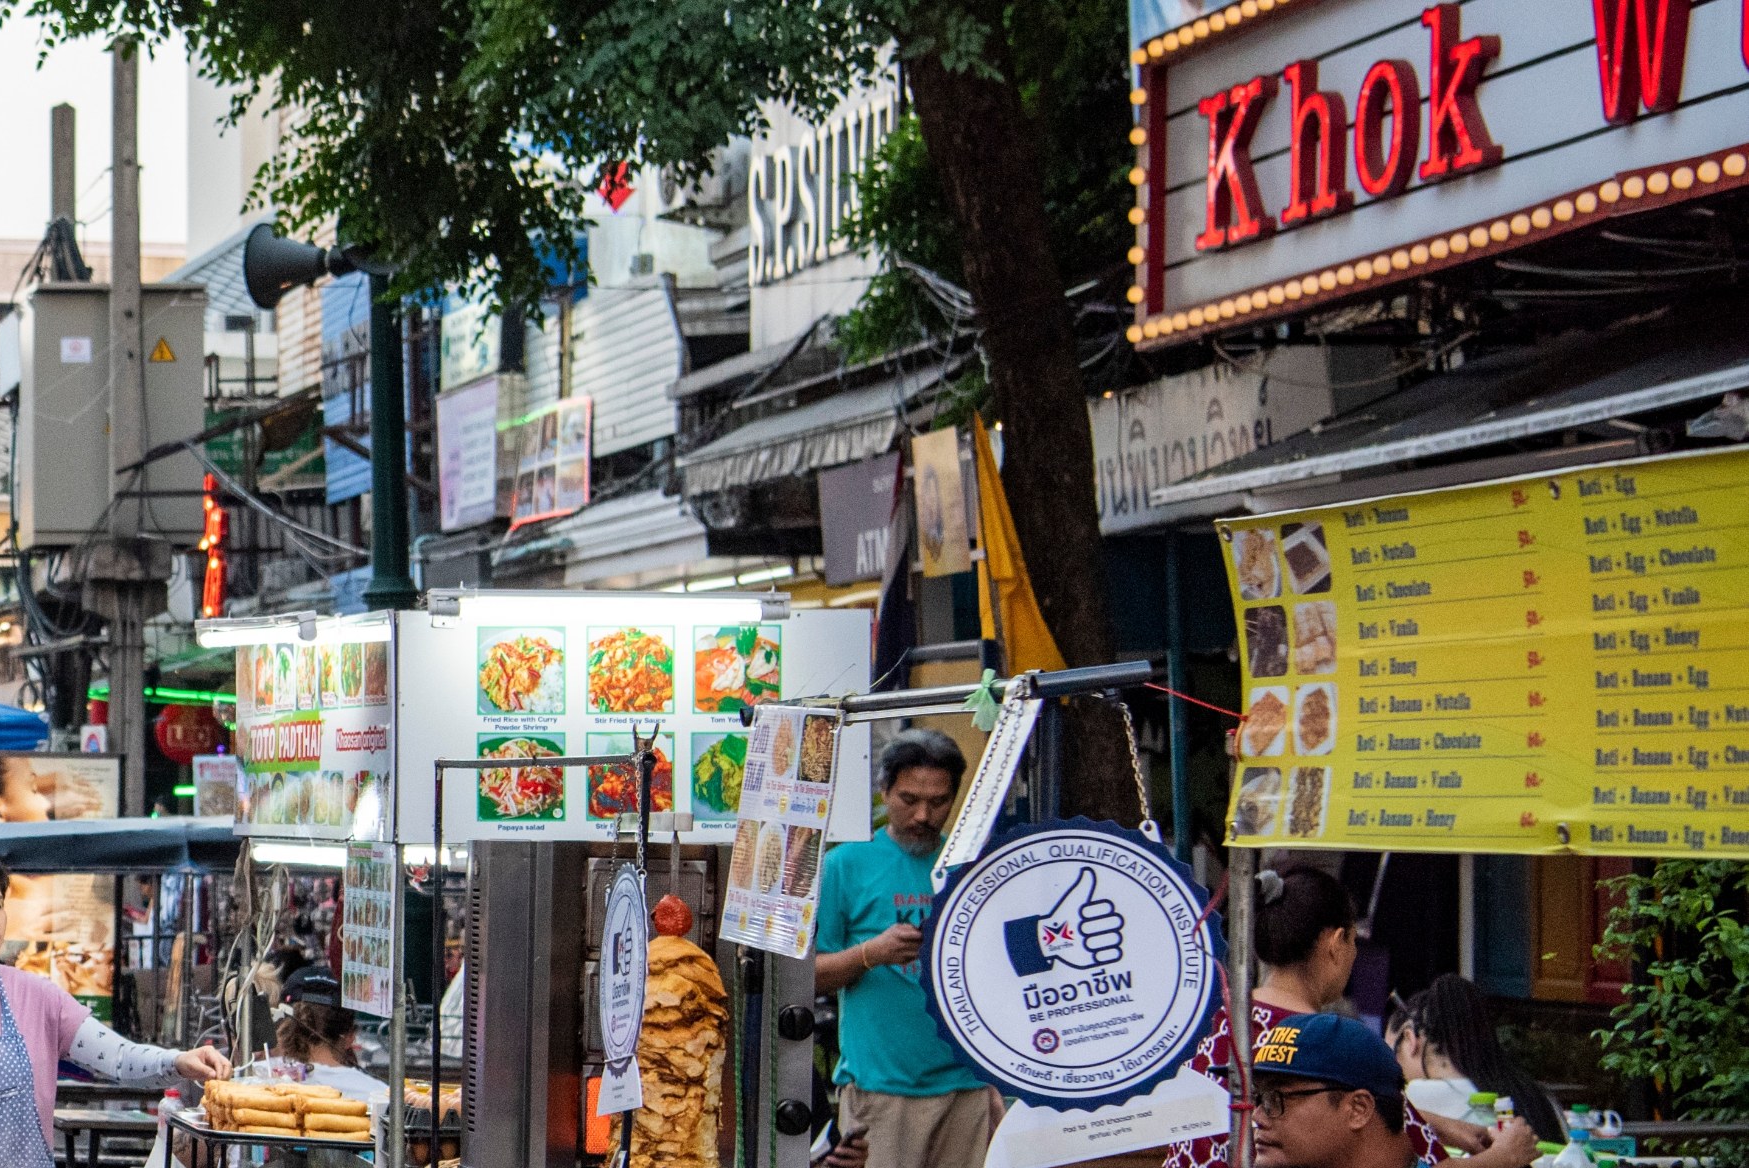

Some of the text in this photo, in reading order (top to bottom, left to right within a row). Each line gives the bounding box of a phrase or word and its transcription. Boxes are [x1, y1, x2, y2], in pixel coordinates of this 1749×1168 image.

[1195, 3, 1504, 252] Khok
[251, 720, 322, 763] TOTO PADTHAI
[498, 823, 545, 833] Papaya salad
[947, 844, 1198, 1036] THAILAND PROFESSIONAL QUALIFICATION INSTITUTE
[1023, 968, 1133, 1011] มืออาชีพ
[1029, 993, 1134, 1023] BE PROFESSIONAL
[1270, 1026, 1301, 1044] THE
